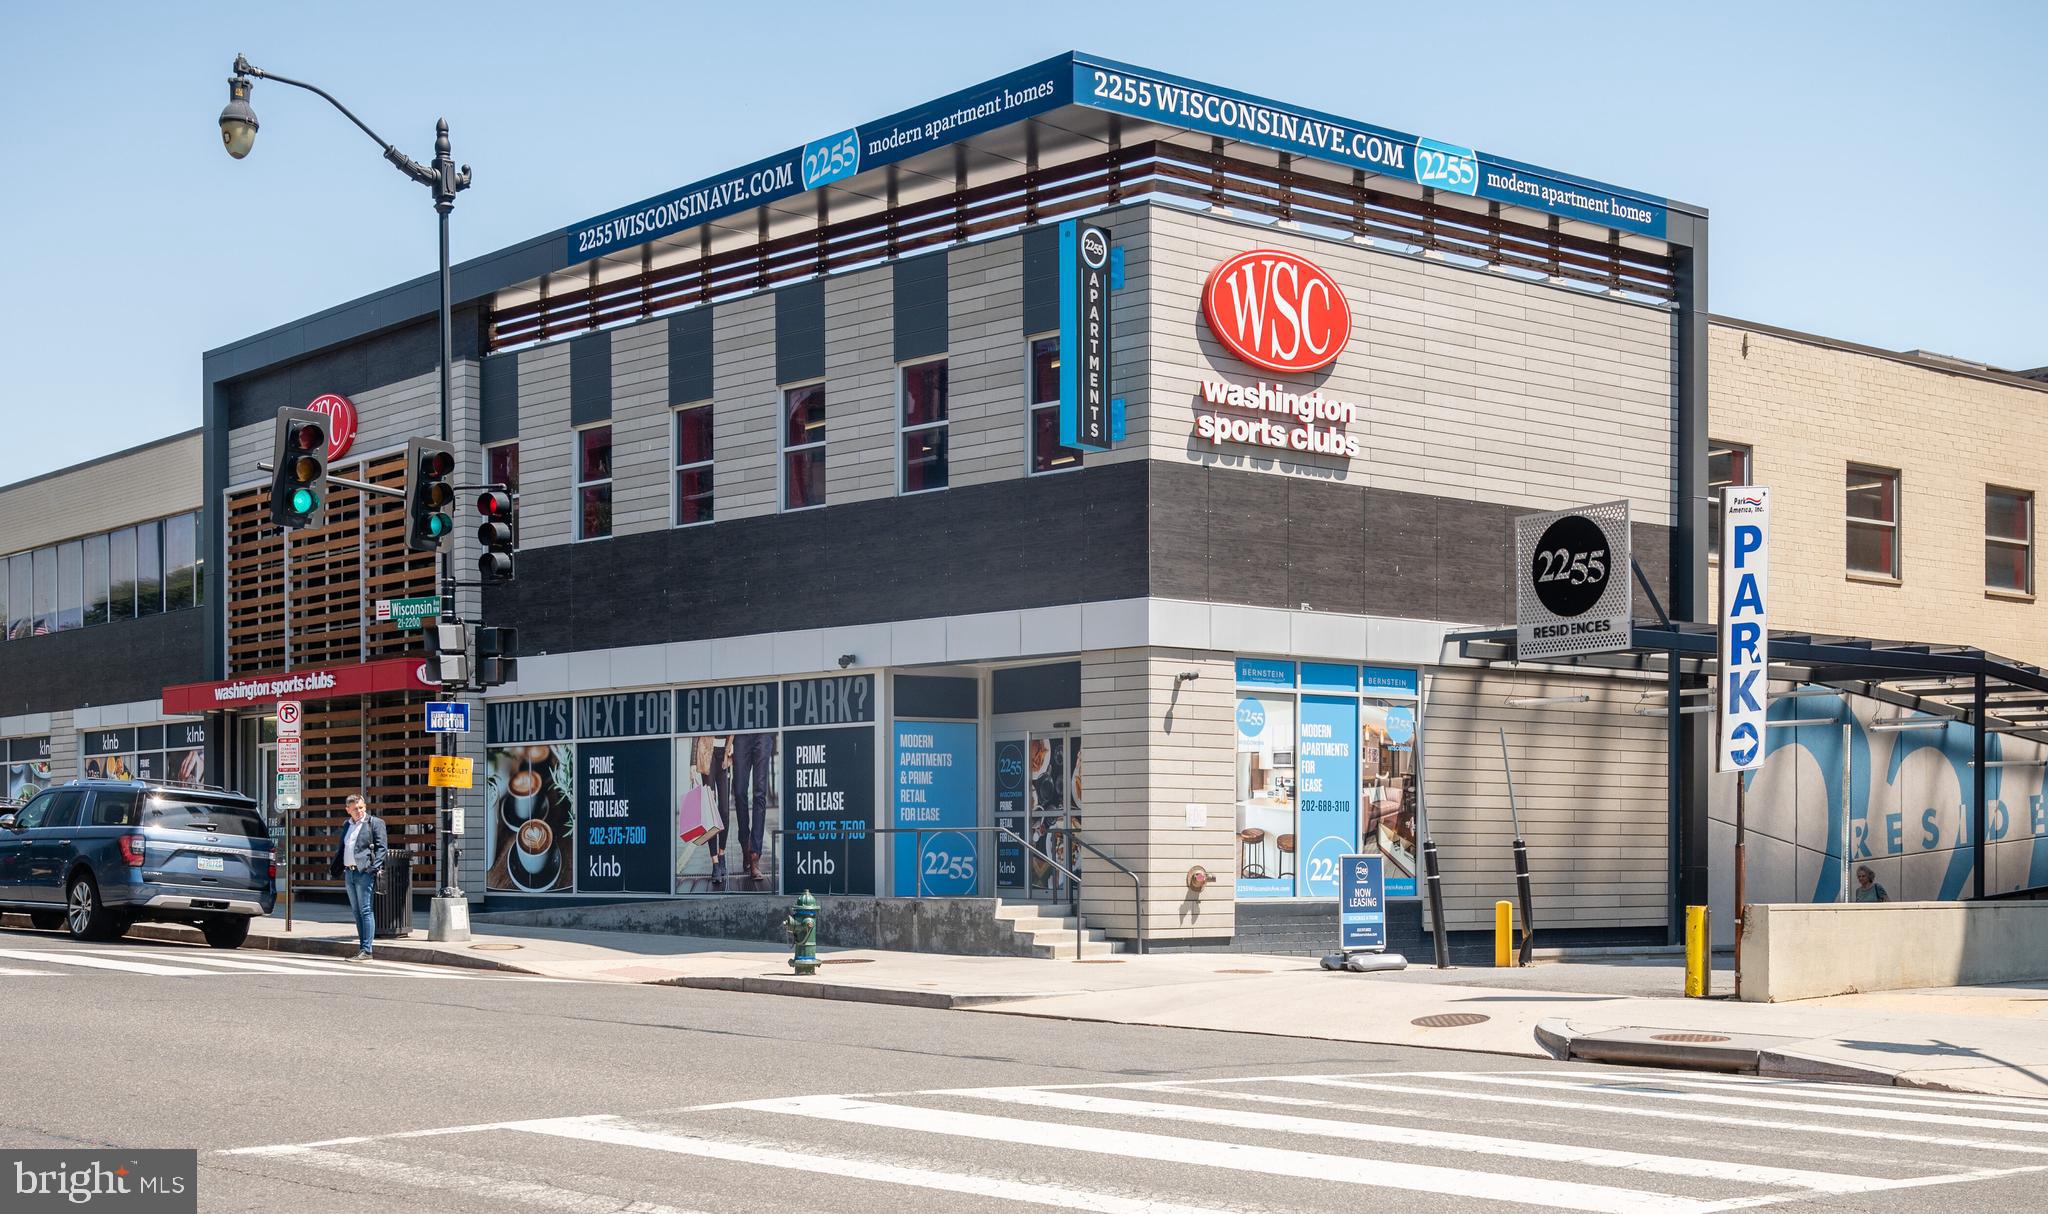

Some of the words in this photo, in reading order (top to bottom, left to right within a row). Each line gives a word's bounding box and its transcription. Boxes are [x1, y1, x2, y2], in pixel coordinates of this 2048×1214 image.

[868, 127, 922, 155] modern
[924, 97, 1001, 138] apartment
[1003, 79, 1054, 108] homes
[1093, 71, 1404, 168] 2255WISCONSINAVE.COM
[806, 136, 856, 183] 2255
[1419, 148, 1474, 184] 2255
[1487, 170, 1538, 196] modern
[1541, 187, 1608, 214] apartment
[1610, 198, 1652, 224] homes
[579, 163, 794, 252] 2255WISCONSINAVE.COM
[1085, 239, 1103, 256] 2255
[1226, 260, 1330, 360] WSC
[1089, 272, 1099, 438] APARTMENTS
[1202, 381, 1357, 424] washington
[1198, 413, 1287, 447] sports
[1290, 427, 1360, 456] clubs
[1538, 548, 1605, 585] 2255
[391, 601, 432, 617] Wisconsin
[1534, 620, 1610, 638] RESIDENCES
[1729, 525, 1764, 715] PARK
[1242, 669, 1285, 678] BERNSTEIN
[1368, 677, 1407, 687] BERNSTEIN
[215, 680, 269, 700] washington
[271, 676, 304, 698] sports
[305, 671, 335, 691] clubs
[496, 699, 567, 743] WHAT'S
[578, 694, 625, 738] NEXT
[634, 693, 670, 735] FOR
[687, 684, 769, 731] GLOVER
[790, 675, 868, 725] PARK?
[1239, 709, 1263, 726] 2255
[430, 718, 465, 728] NORTON
[1302, 724, 1332, 738] MODERN
[1388, 716, 1412, 731] 2255
[40, 740, 49, 755] kln
[103, 734, 119, 750] klnb
[900, 734, 933, 748] MODERN
[1302, 742, 1348, 757] APARTMENTS
[796, 745, 826, 764] PRIME
[900, 753, 952, 767] APARTMENTS
[589, 756, 614, 774] PRIME
[1000, 758, 1022, 775] 2255
[1302, 760, 1315, 774] FOR
[589, 778, 615, 796] RETAIL
[796, 768, 828, 788] RETAIL
[900, 771, 907, 785] &
[908, 771, 933, 785] PRIME
[1302, 779, 1322, 792] LEASE
[796, 793, 814, 811] FOR
[816, 792, 844, 810] LEASE
[900, 789, 926, 803] RETAIL
[589, 801, 604, 818] FOR
[606, 800, 629, 817] LEASE
[901, 808, 915, 821] FOR
[917, 808, 940, 821] LEASE
[1000, 801, 1013, 811] PRIME
[1302, 800, 1350, 812] 202-688-3110
[589, 826, 647, 845] 202-375-7500
[590, 855, 621, 877] klnb
[797, 851, 835, 874] klnb
[925, 851, 974, 879] 2255
[1000, 862, 1016, 874] klnb
[1354, 888, 1371, 897] NOW
[1349, 898, 1377, 907] LEASING
